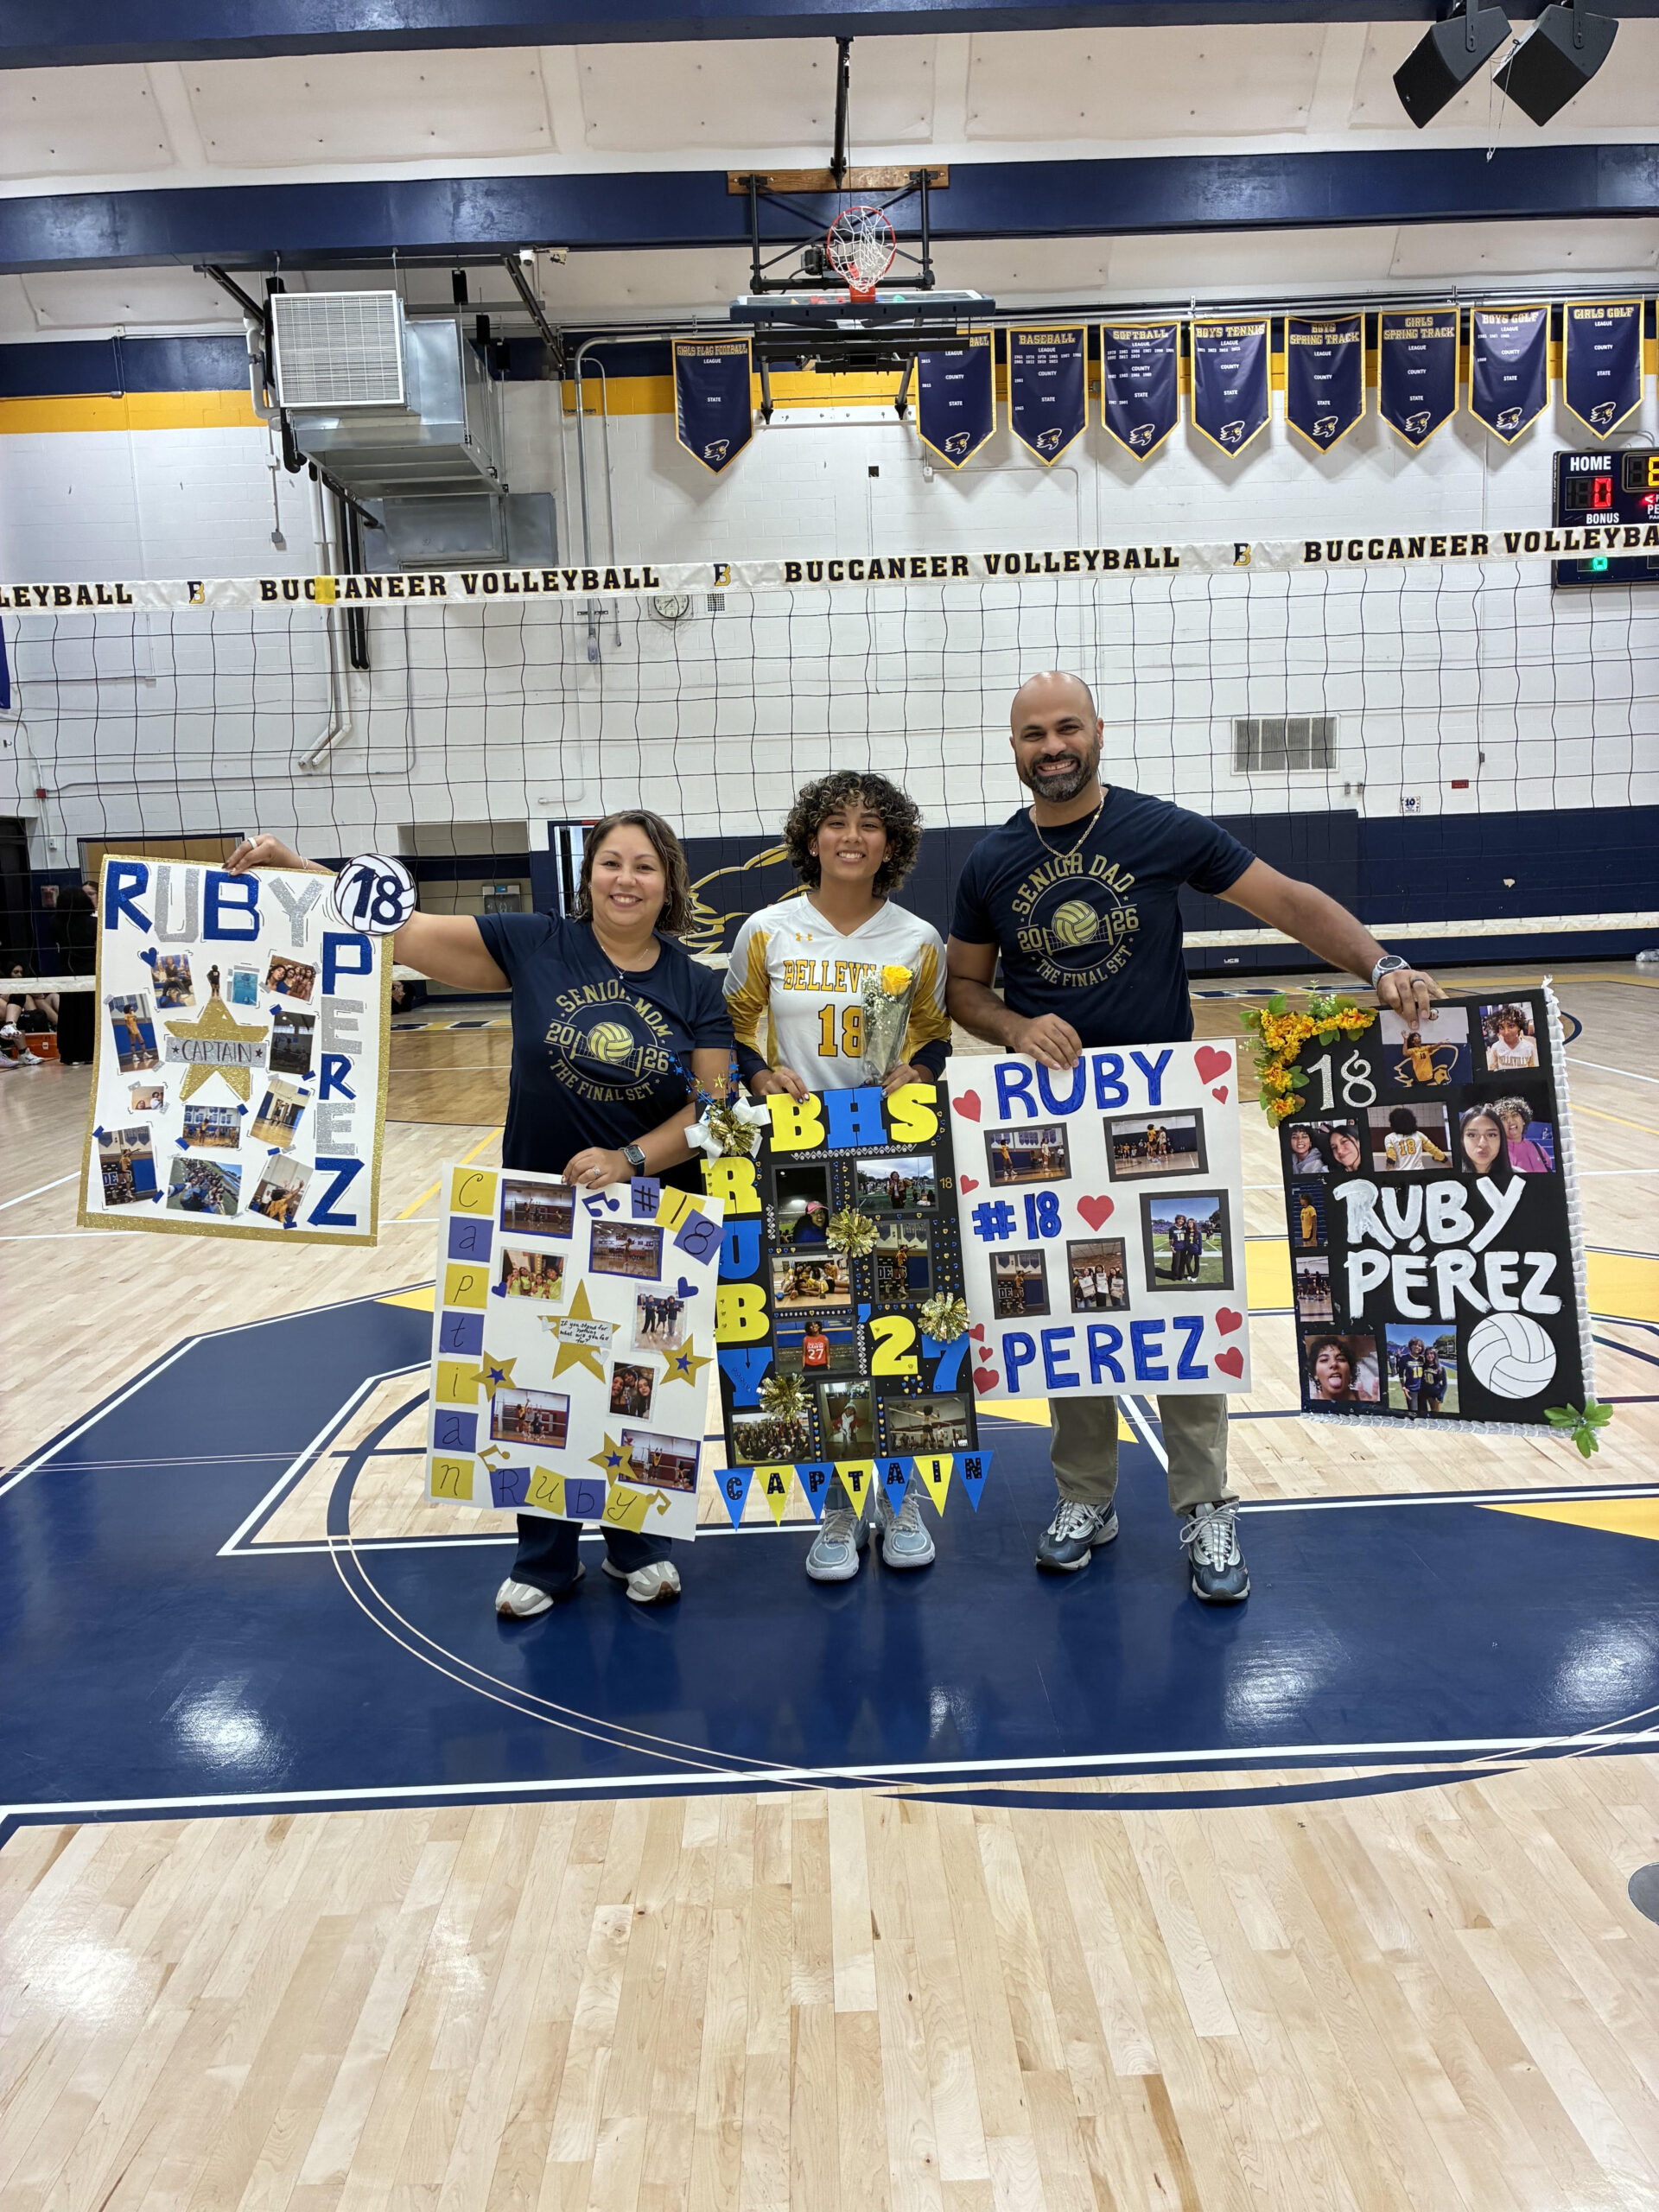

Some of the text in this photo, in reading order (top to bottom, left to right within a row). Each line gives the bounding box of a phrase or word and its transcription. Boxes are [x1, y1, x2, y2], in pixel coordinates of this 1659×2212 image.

[1196, 324, 1265, 338] BOYS TENNIS
[1312, 323, 1337, 334] BOYS
[1405, 316, 1433, 327] GIRLS
[1482, 311, 1539, 324] BOYS GOLF
[1573, 307, 1634, 320] GIRLS GOLF
[677, 344, 747, 356] GIRLS FLAG FOOTBALL
[1019, 333, 1076, 345] BASEBALL
[1113, 329, 1169, 340] SOFTBALL
[1290, 332, 1359, 345] SPRING TRACK
[1383, 327, 1455, 340] SPRING TRACK
[1570, 456, 1611, 472] HOME
[1594, 477, 1611, 507] 0
[1586, 513, 1619, 524] BONUS
[785, 547, 1179, 583] BUCCANEER VOLLEYBALL
[1304, 533, 1489, 563] BUCCANEER
[260, 567, 659, 601] BUCANEER VOLLEYBALL
[1089, 855, 1135, 893] DAD
[105, 861, 324, 947] RUBY
[353, 868, 404, 925] 18
[1017, 908, 1139, 951] 20 26
[1037, 944, 1134, 987] THE FINAL SET
[635, 998, 673, 1037] MOM
[818, 1004, 861, 1058] 18
[182, 1039, 251, 1062] CAPTAIN
[546, 1022, 669, 1071] 20 26
[307, 932, 373, 1226] PEREZ
[550, 1059, 654, 1101] THE FINAL SET
[995, 1049, 1173, 1120] RUBY
[1308, 1050, 1376, 1109] 18
[766, 1084, 938, 1152] BHS
[1399, 1139, 1416, 1155] 18
[940, 1177, 953, 1189] 18
[634, 1185, 715, 1255] #18
[972, 1191, 1061, 1242] #18
[1333, 1176, 1525, 1253] RUBY
[701, 1156, 773, 1406] RUBY
[808, 1348, 823, 1360] 27
[1002, 1315, 1209, 1392] PEREZ
[499, 1469, 638, 1521] Ruby
[727, 1458, 982, 1500] CAPTAIN
